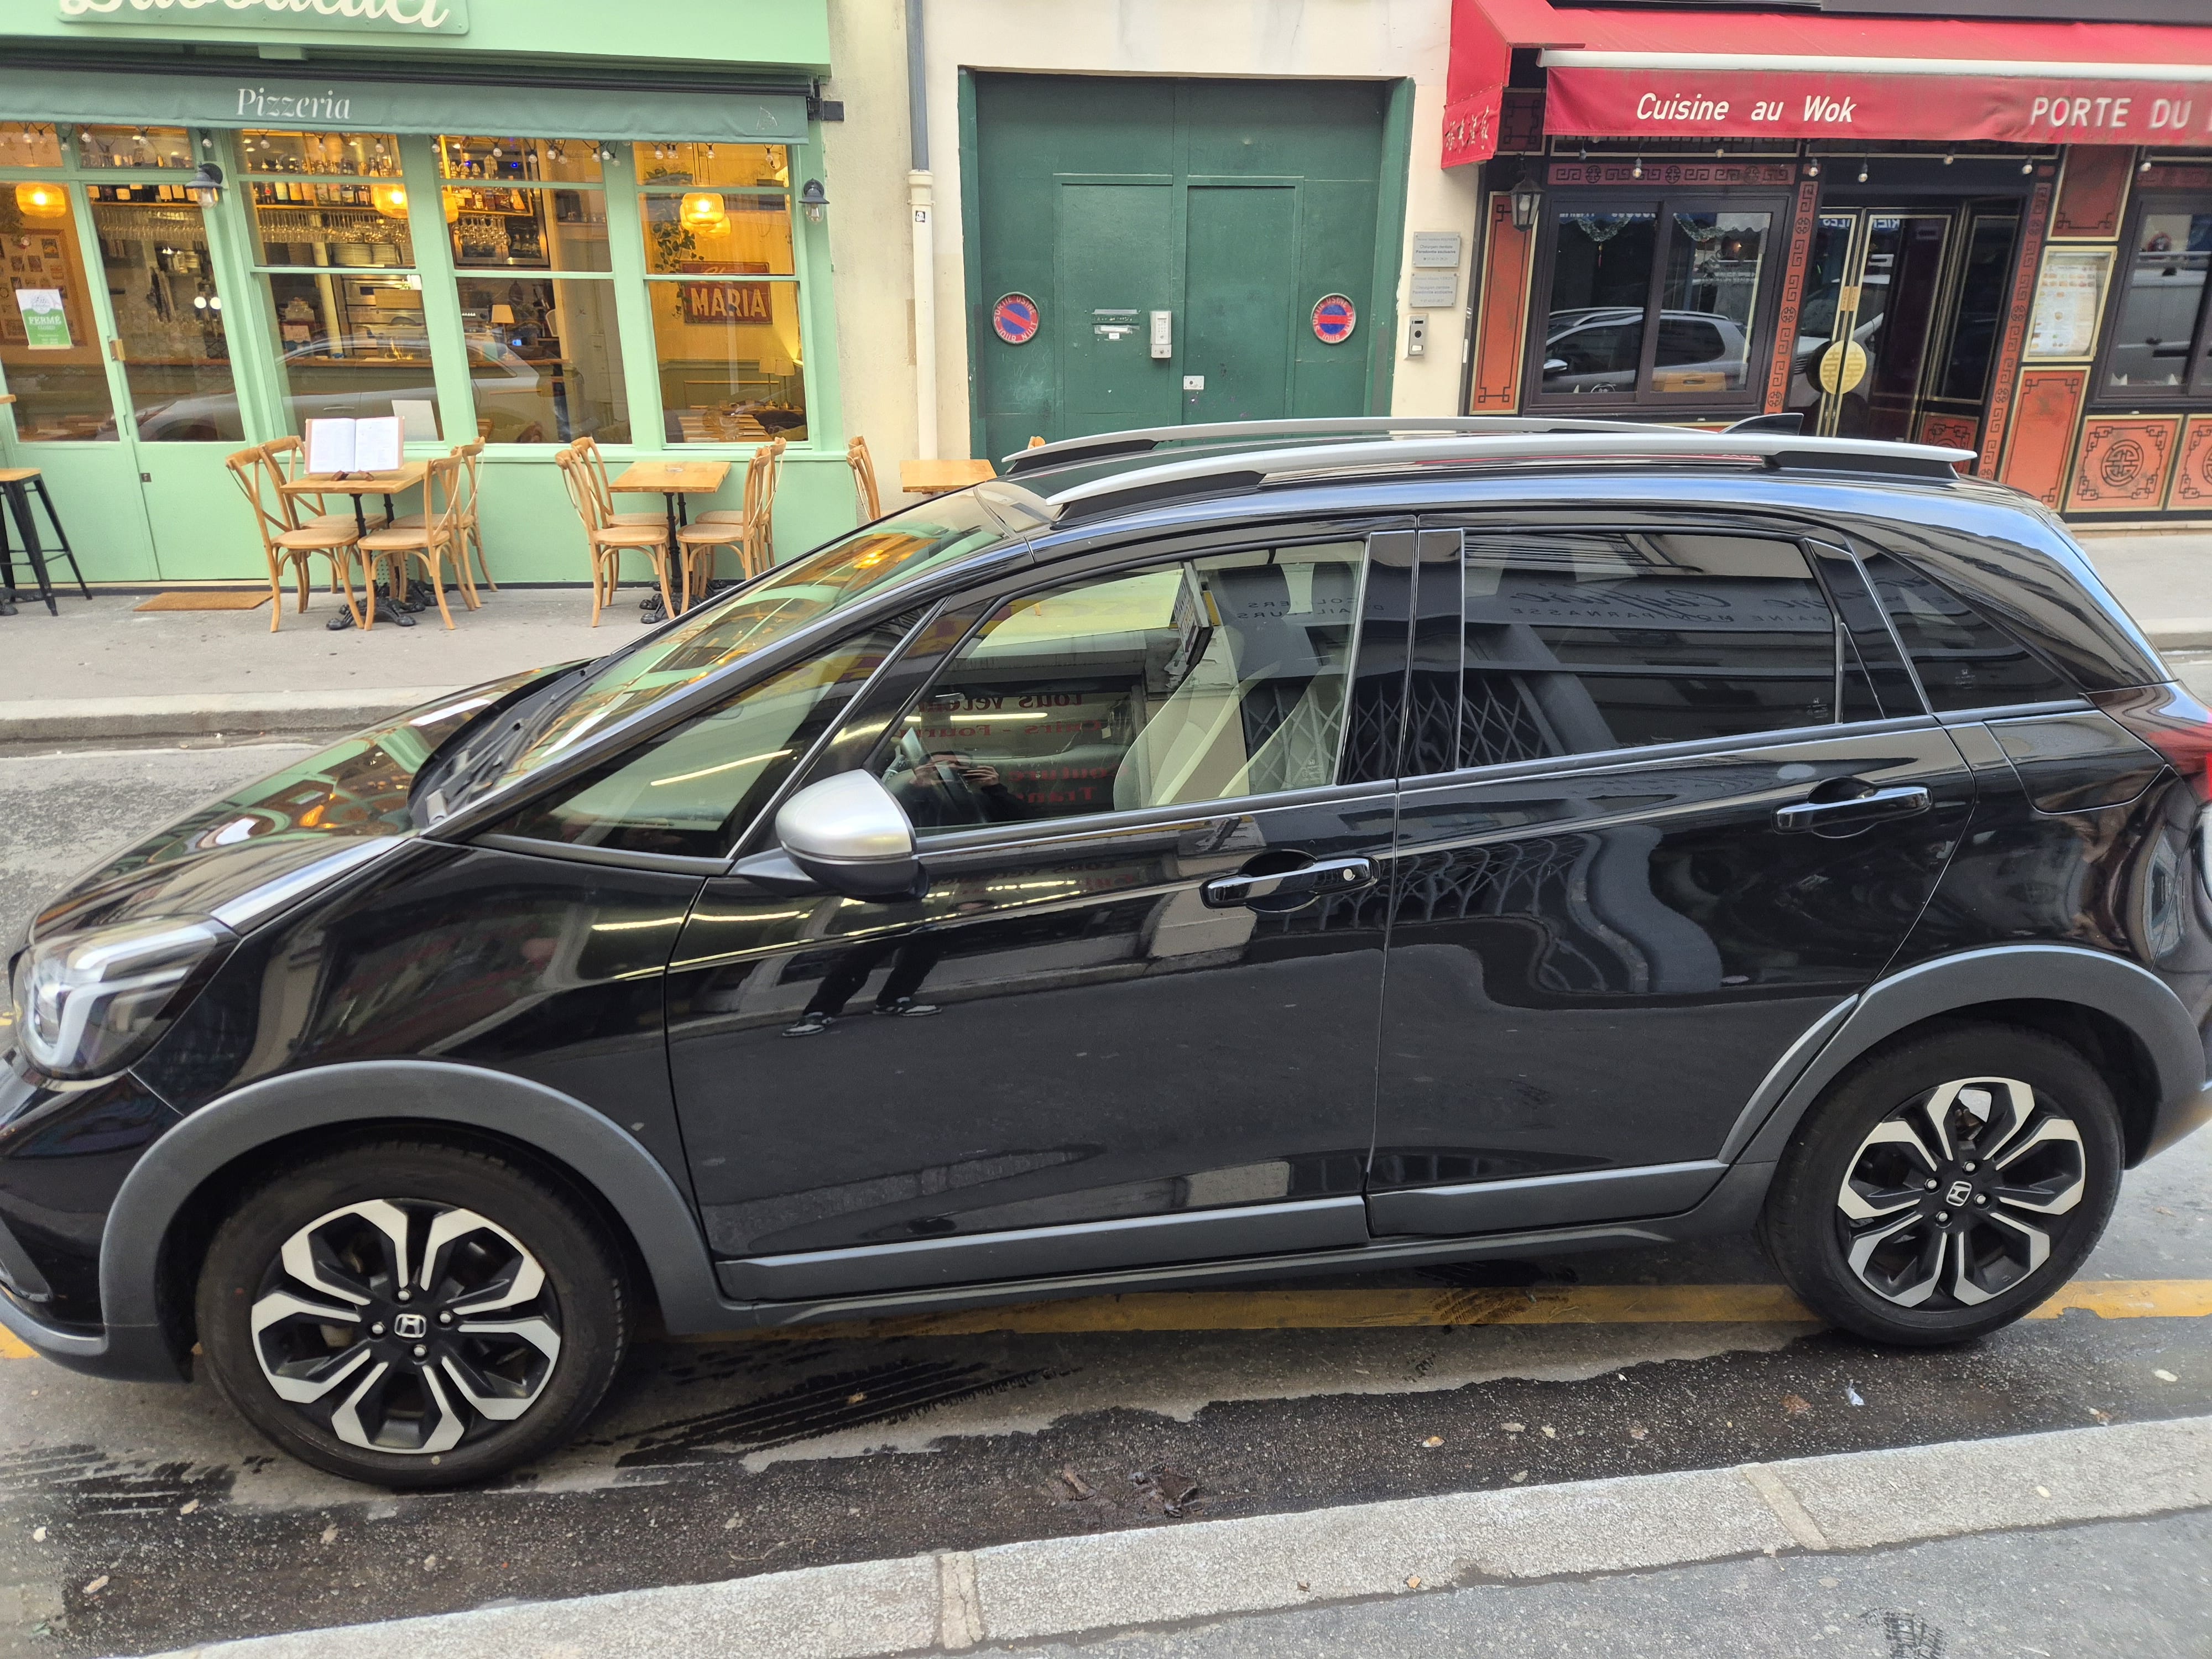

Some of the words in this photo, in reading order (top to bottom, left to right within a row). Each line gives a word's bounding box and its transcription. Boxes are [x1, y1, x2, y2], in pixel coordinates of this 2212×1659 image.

[237, 87, 350, 119] Pizzeria
[1636, 92, 1730, 122] Cuisine
[1750, 98, 1784, 122] au
[1803, 96, 1856, 123] Wok
[2030, 97, 2131, 128] PORTE
[2149, 99, 2192, 129] DU
[690, 287, 767, 317] MARIA
[1016, 296, 1037, 315] USINE
[28, 315, 62, 325] FERMÉ
[999, 328, 1016, 341] JOUR
[1021, 321, 1037, 341] NUIT
